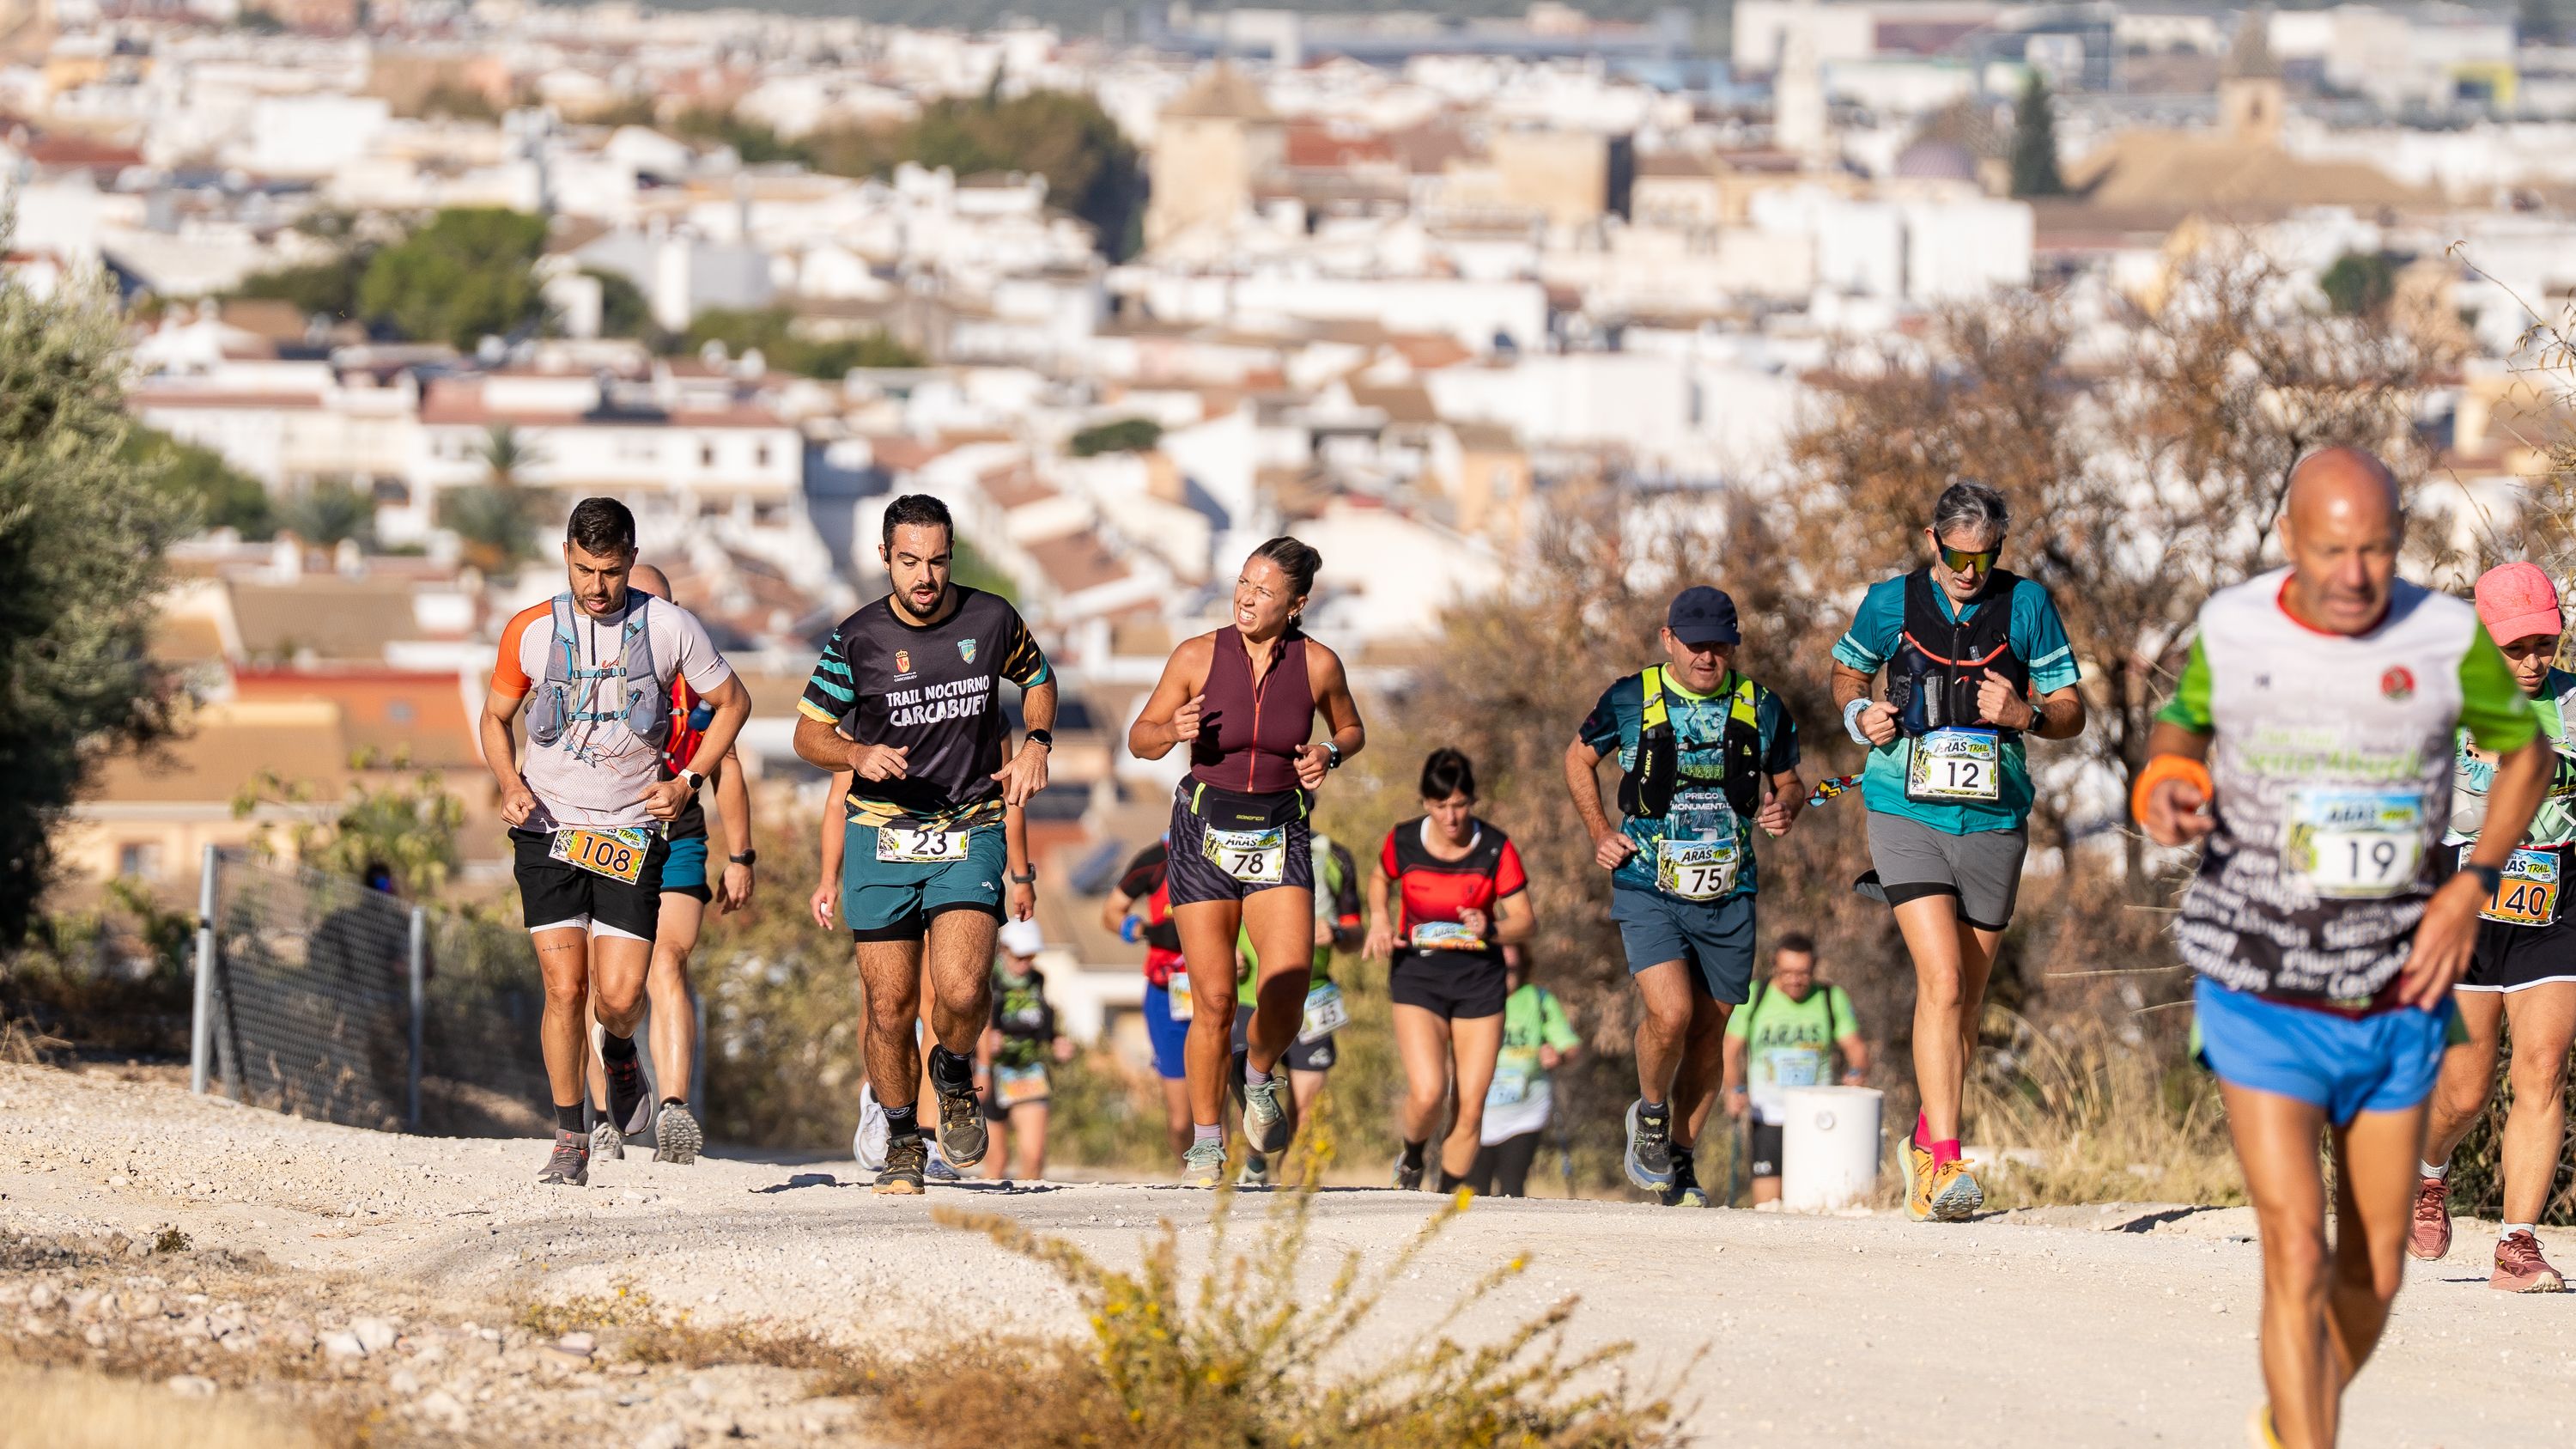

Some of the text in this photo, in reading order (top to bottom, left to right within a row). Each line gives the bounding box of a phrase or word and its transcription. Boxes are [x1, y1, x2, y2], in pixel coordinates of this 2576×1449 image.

[886, 675, 989, 707] TRAIL NOCTURNO
[890, 693, 989, 727] CARCABUEY
[1935, 742, 1989, 753] ARAS TRAIL
[1947, 762, 1979, 788] 12
[619, 829, 640, 841] TRAIL
[912, 829, 947, 855] 23
[1225, 835, 1258, 846] ARAS
[582, 836, 631, 872] 108
[1232, 853, 1264, 874] 78
[1680, 848, 1730, 862] ARAS TRAIL
[2348, 839, 2396, 879] 19
[1692, 868, 1722, 892] 75
[2527, 864, 2549, 873] TRAIL
[2491, 885, 2547, 916] 140
[1756, 1022, 1821, 1045] ARAS
